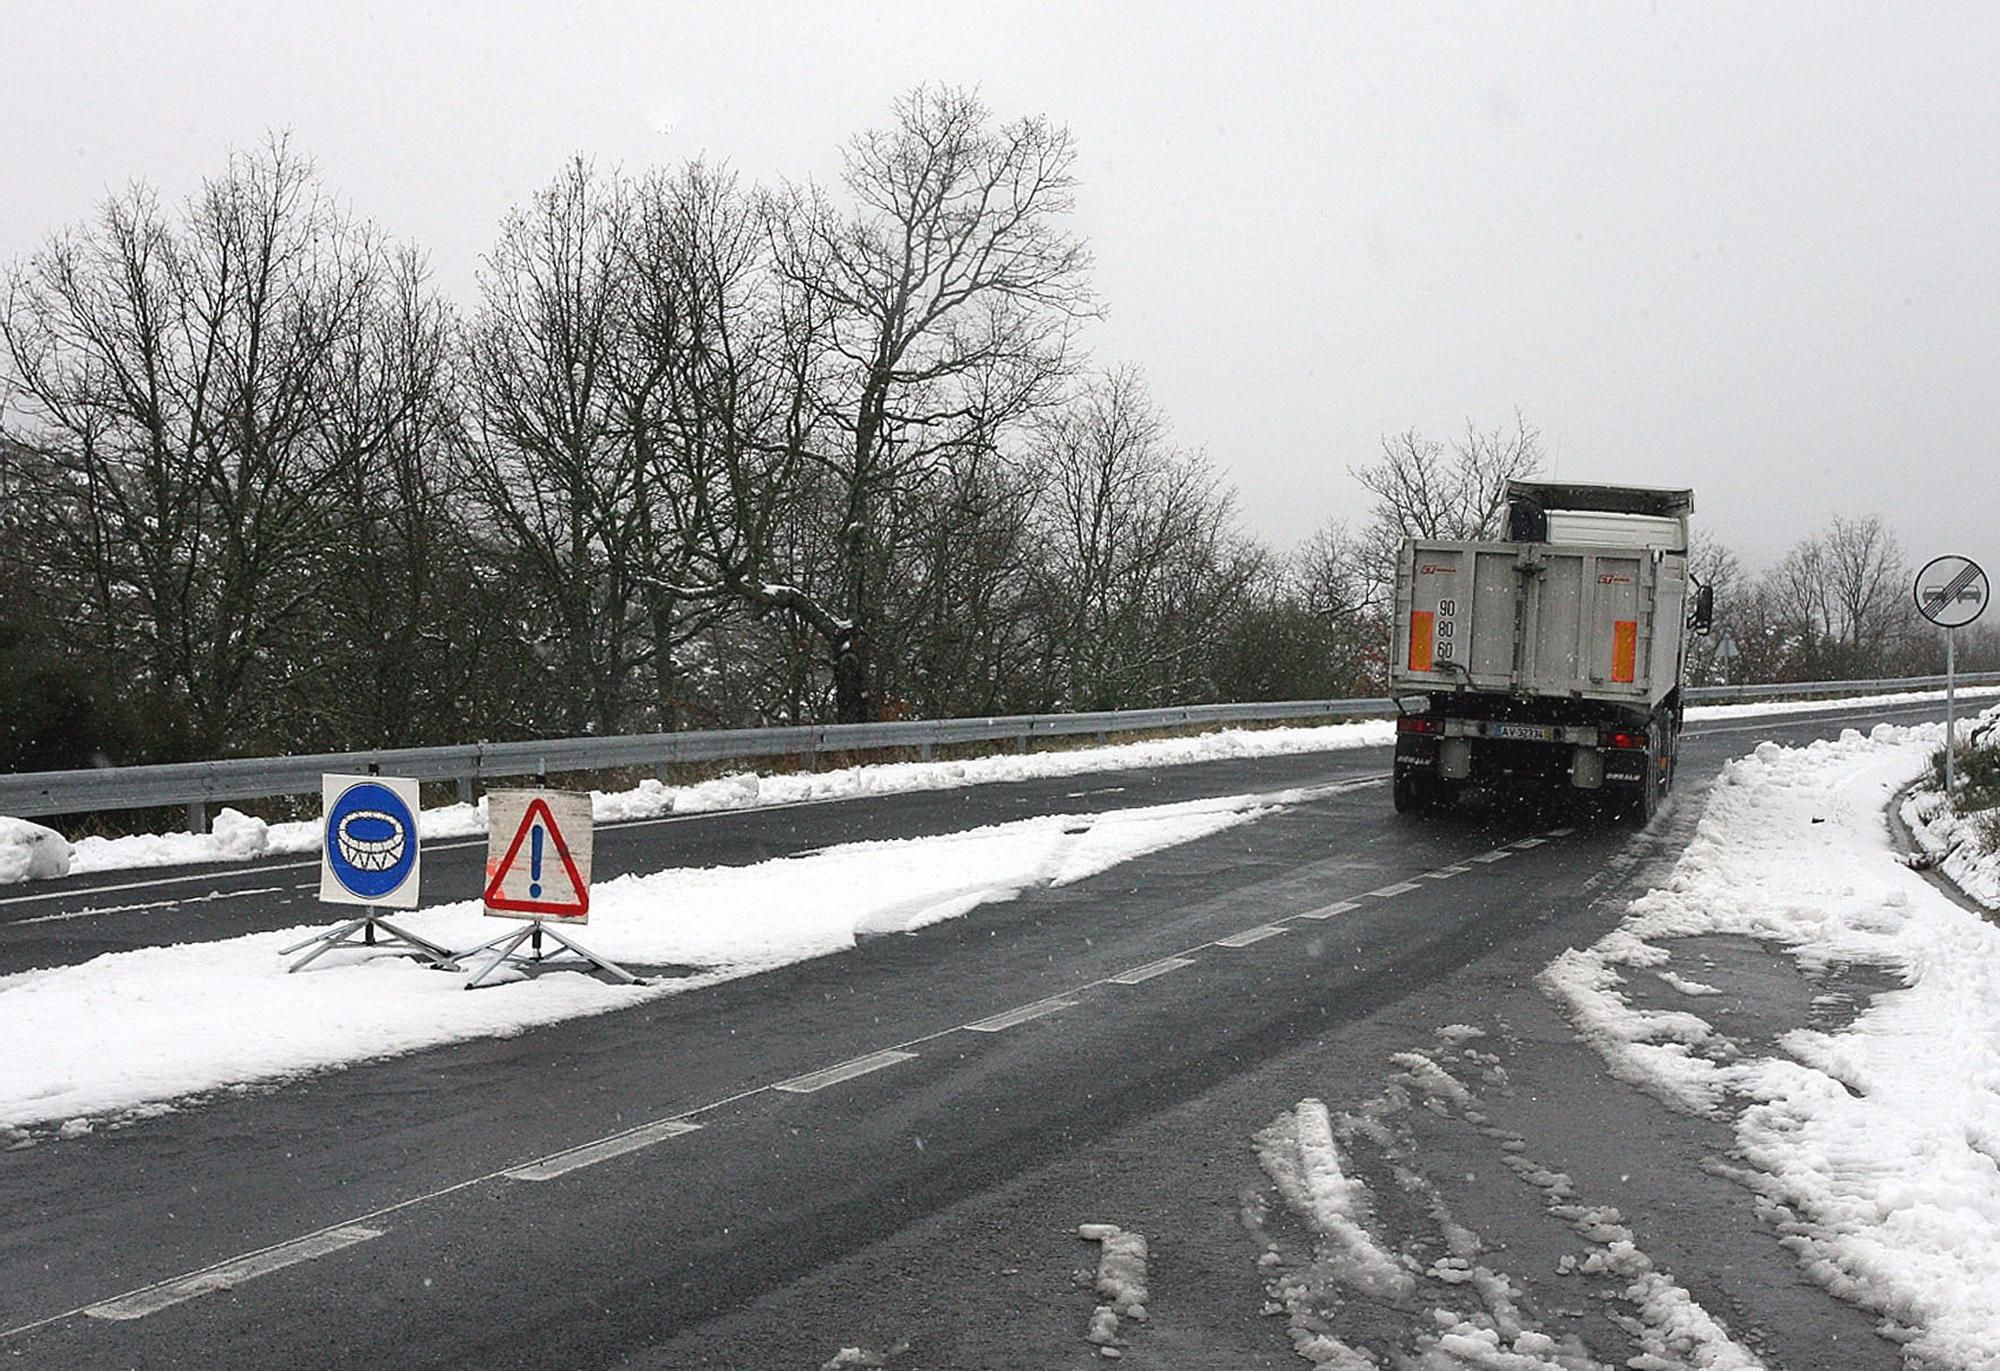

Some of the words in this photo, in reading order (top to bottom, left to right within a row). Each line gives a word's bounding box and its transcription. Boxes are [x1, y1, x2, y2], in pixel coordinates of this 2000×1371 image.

[1440, 600, 1455, 617] 90
[1438, 620, 1453, 637] 80
[1437, 641, 1453, 658] 60
